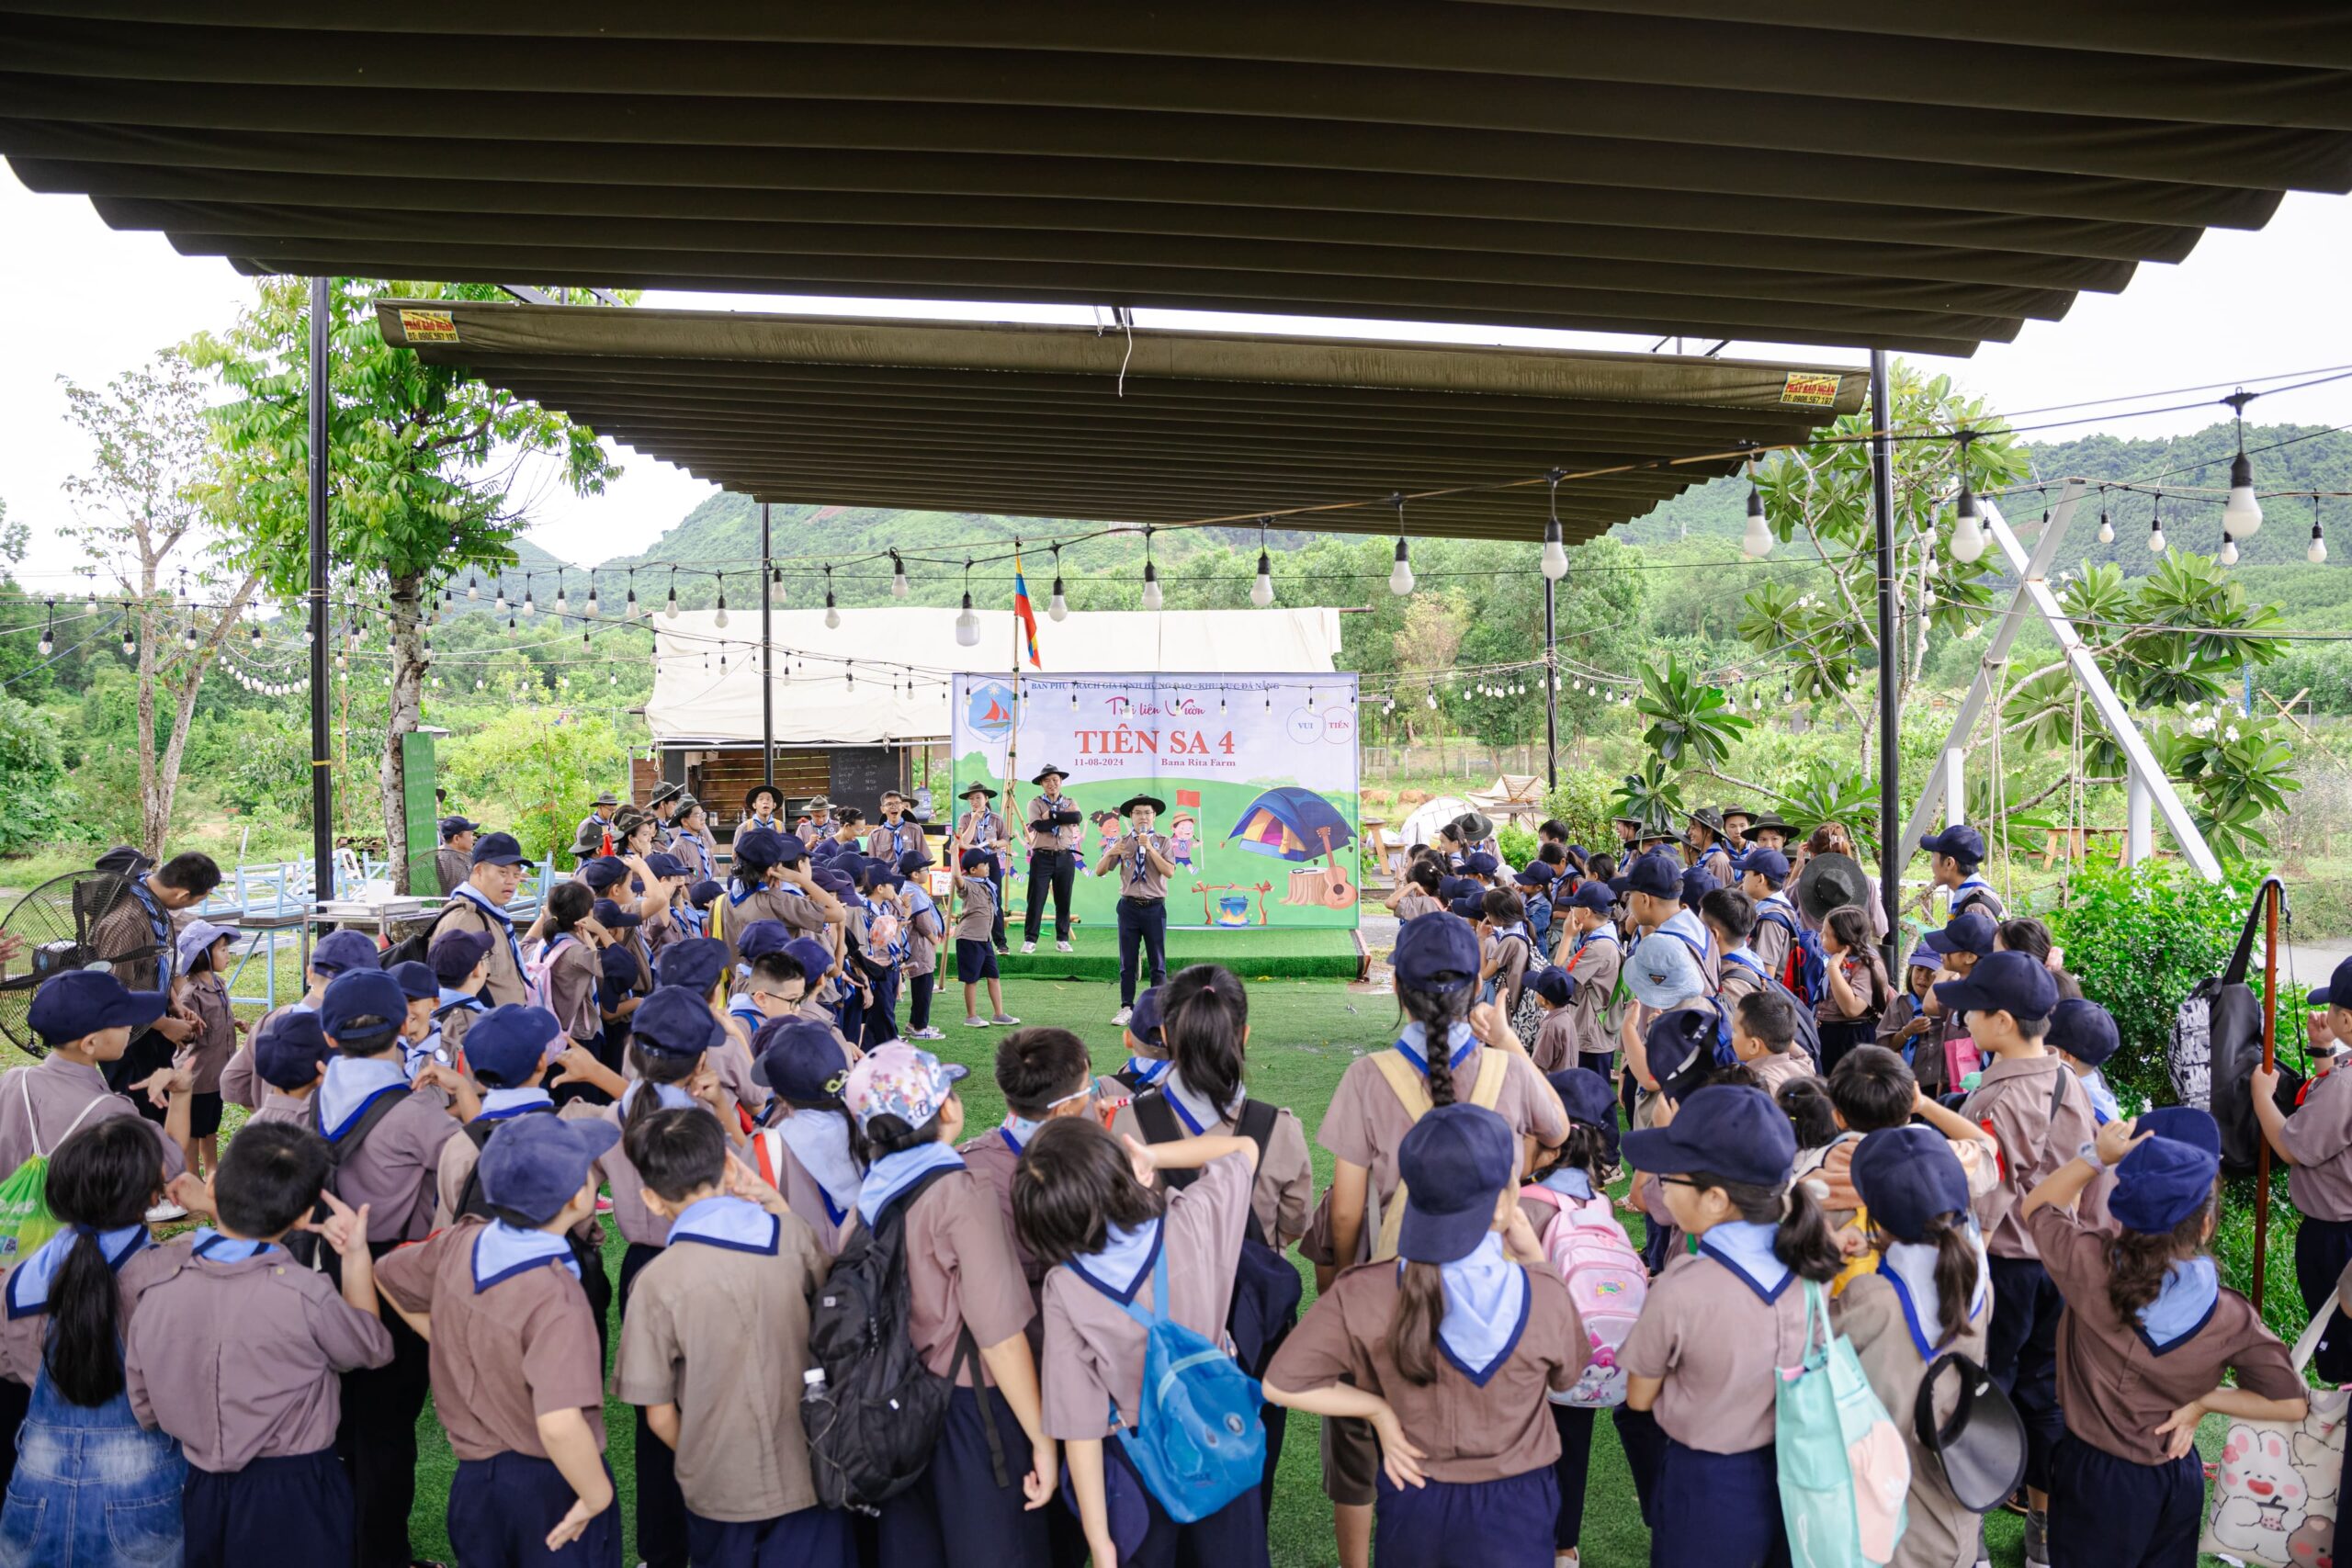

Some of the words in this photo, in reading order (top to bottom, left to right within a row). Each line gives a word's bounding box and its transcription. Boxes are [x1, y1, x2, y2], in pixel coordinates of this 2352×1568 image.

[1050, 682, 1068, 691] PHỤ
[1071, 682, 1100, 690] RÁCH
[1242, 681, 1253, 690] ĐÀ
[1104, 695, 1136, 716] Tri
[1139, 702, 1161, 716] liên
[1074, 723, 1160, 754] TIÊN
[1170, 730, 1210, 754] SA
[1218, 730, 1235, 754] 4
[1074, 758, 1124, 766] 11-08-2024
[1161, 758, 1185, 766] Bana
[1188, 758, 1208, 766] Rita
[1210, 758, 1236, 767] Farm
